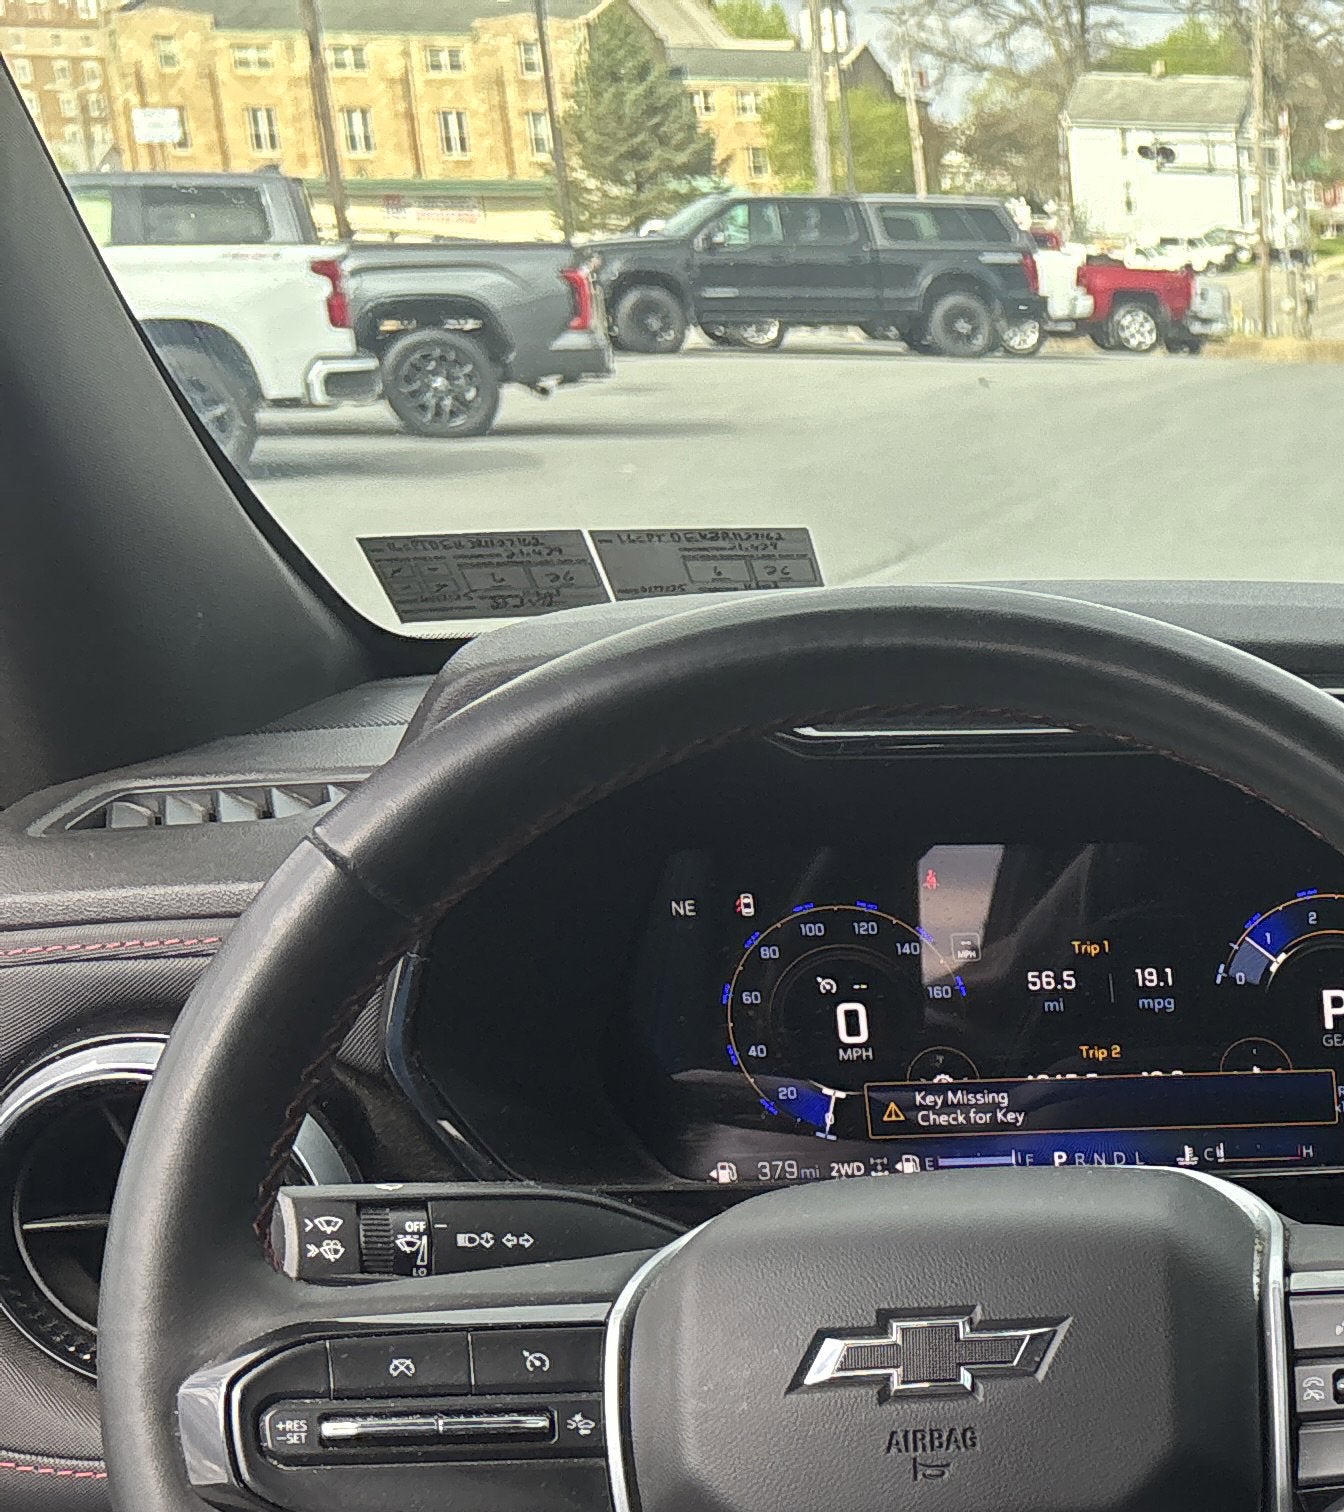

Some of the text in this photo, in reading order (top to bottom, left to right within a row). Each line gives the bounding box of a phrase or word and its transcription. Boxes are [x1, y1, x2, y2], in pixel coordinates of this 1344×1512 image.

[671, 899, 697, 916] NE
[1308, 911, 1317, 925] 2
[799, 923, 825, 937] 100
[852, 921, 878, 935] 120
[1264, 932, 1272, 945] 1
[760, 945, 780, 959] 80
[894, 942, 921, 956] 140
[957, 950, 976, 960] MPH
[1071, 940, 1109, 957] Trip 1
[1027, 970, 1076, 991] 56.5
[1134, 967, 1173, 987] 19.1
[1235, 972, 1245, 985] 0
[741, 991, 761, 1005] 60
[926, 986, 952, 999] 160
[1044, 997, 1064, 1012] mi
[1138, 997, 1175, 1013] mpg
[836, 1002, 869, 1044] 0
[748, 1044, 767, 1058] 40
[838, 1047, 873, 1061] MPH
[1078, 1044, 1121, 1062] Trip 2
[777, 1087, 797, 1100] 20
[914, 1089, 1009, 1110] Key Missing
[917, 1107, 1025, 1127] Check for Key
[1203, 1147, 1215, 1162] C
[1302, 1145, 1314, 1158] H
[924, 1157, 936, 1172] E
[1025, 1153, 1034, 1167] F
[1053, 1150, 1146, 1168] P R N D L
[757, 1160, 821, 1183] 379 mi
[828, 1160, 866, 1178] 2WD
[404, 1220, 427, 1233] OFF
[412, 1267, 428, 1277] LO
[884, 1426, 979, 1454] AIRBAG
